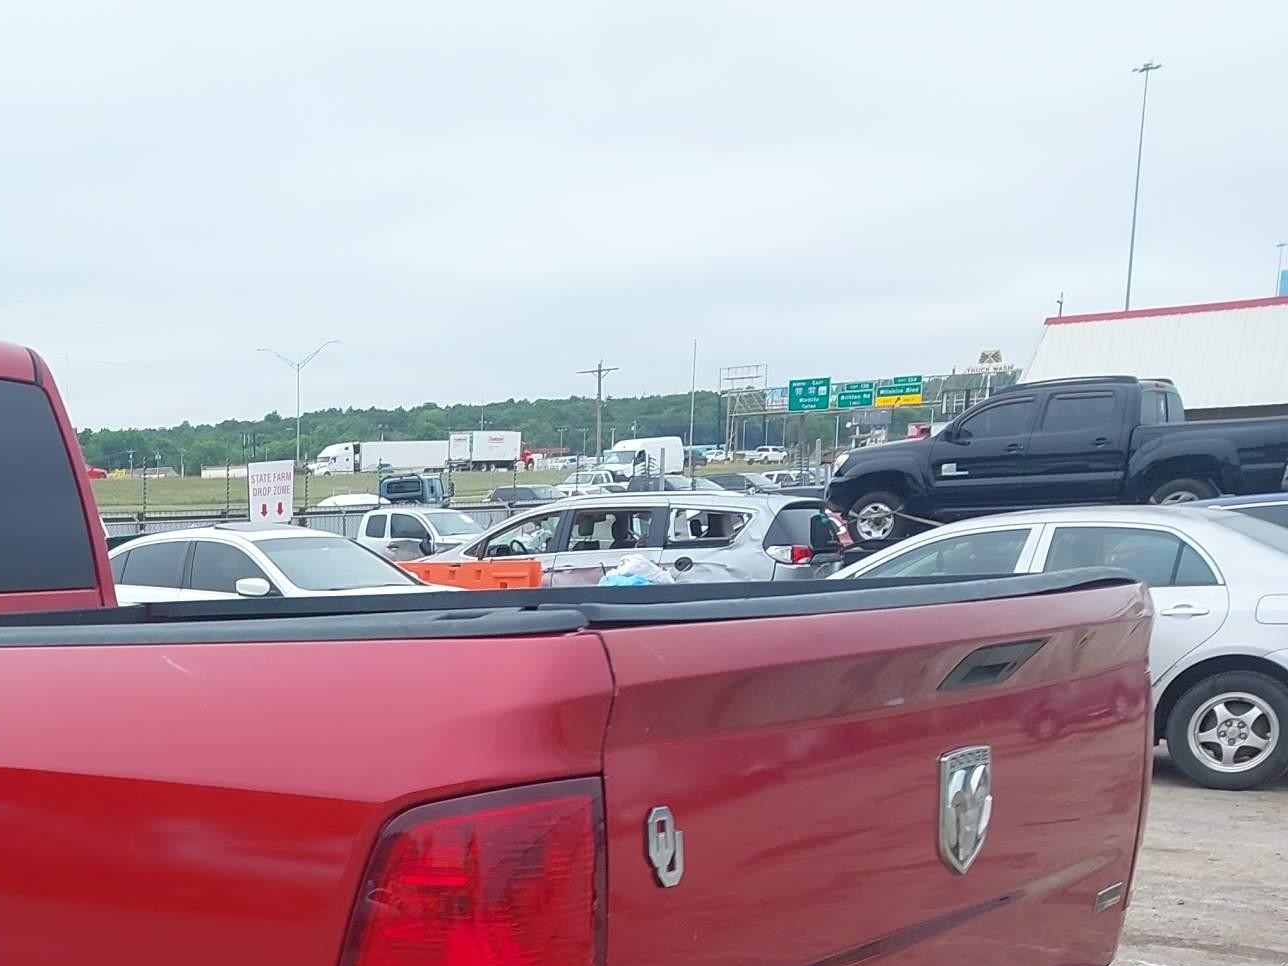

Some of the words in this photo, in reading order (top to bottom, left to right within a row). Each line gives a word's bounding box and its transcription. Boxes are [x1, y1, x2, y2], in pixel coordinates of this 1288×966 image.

[251, 473, 271, 483] STATE
[273, 472, 291, 482] FARM
[252, 486, 272, 497] DROP
[273, 485, 291, 496] ZONE
[950, 749, 989, 769] DODGE
